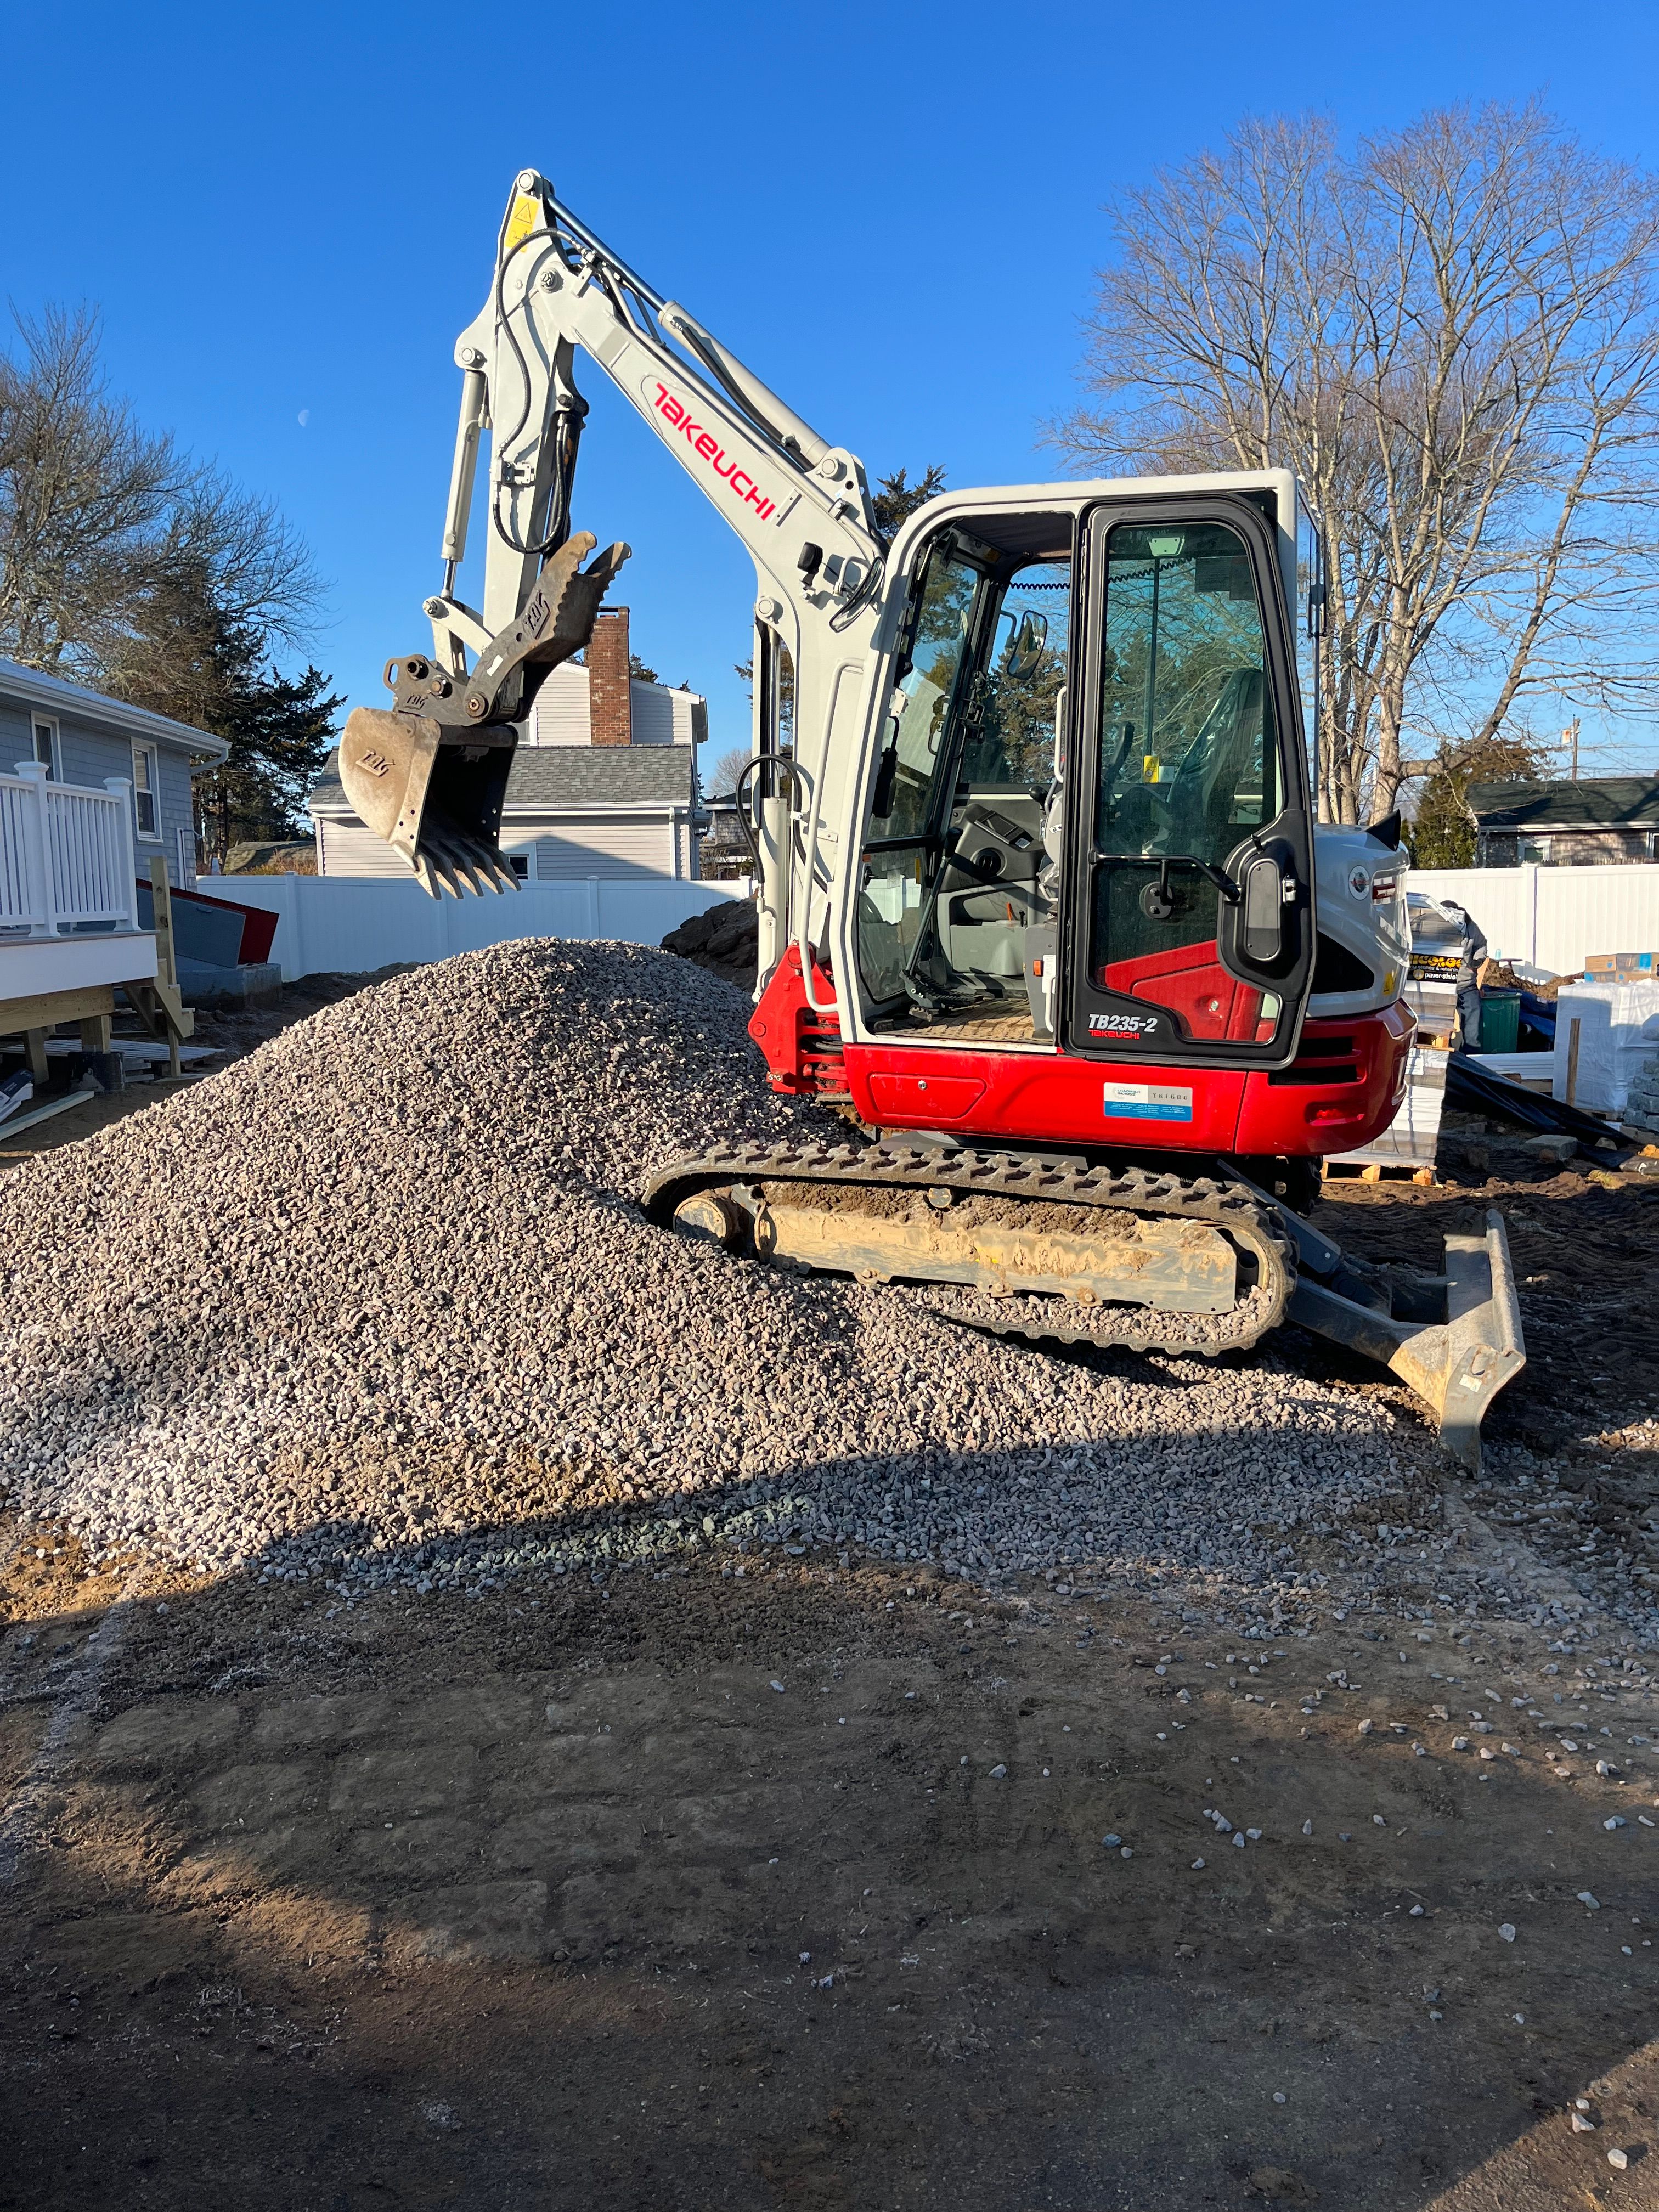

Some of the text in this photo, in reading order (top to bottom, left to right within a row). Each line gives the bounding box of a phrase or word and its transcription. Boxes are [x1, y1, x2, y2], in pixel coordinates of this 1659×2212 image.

[654, 382, 776, 521] TAKEUCHI
[1088, 1013, 1158, 1032] TB235-2
[1088, 1029, 1140, 1040] TAKEUCHI
